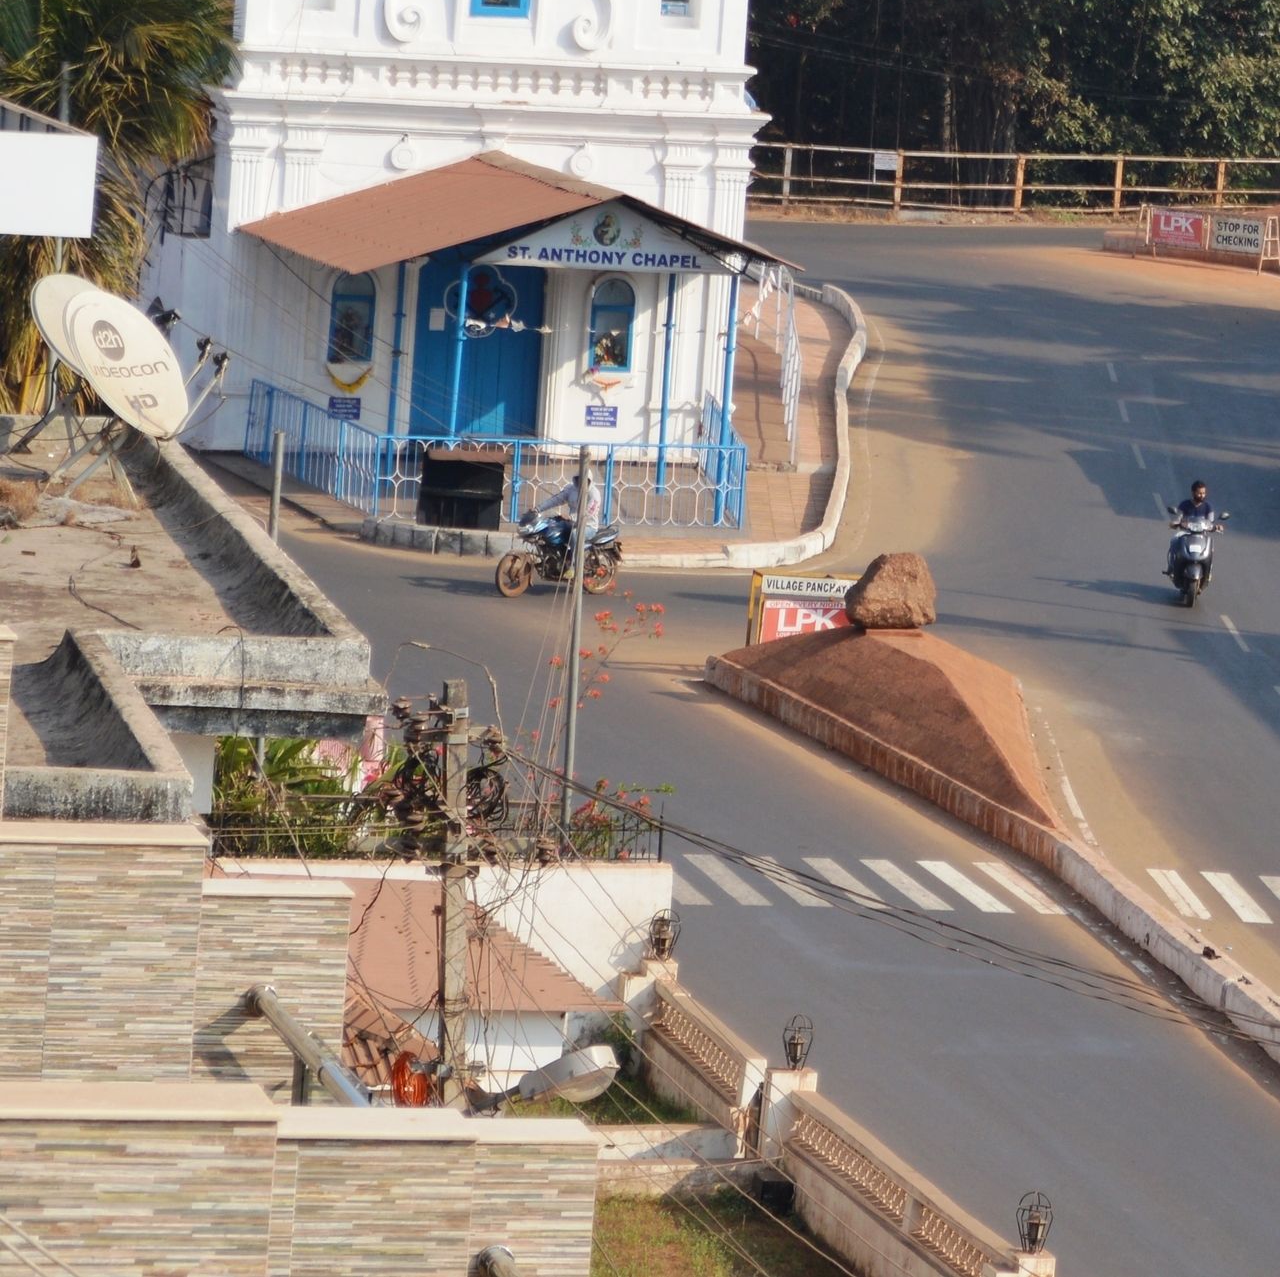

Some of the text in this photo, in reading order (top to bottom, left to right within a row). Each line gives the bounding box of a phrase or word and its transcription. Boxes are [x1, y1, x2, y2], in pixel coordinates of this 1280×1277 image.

[1160, 214, 1194, 234] LPK
[1217, 221, 1260, 235] STOP FOR
[1216, 234, 1259, 249] CHECKING
[507, 245, 702, 269] ST. ANTHONY CHAPEL
[95, 328, 123, 349] d2h
[124, 393, 159, 410] HD
[766, 578, 848, 594] VILLAGE PANCHAY
[777, 608, 840, 632] LPK
